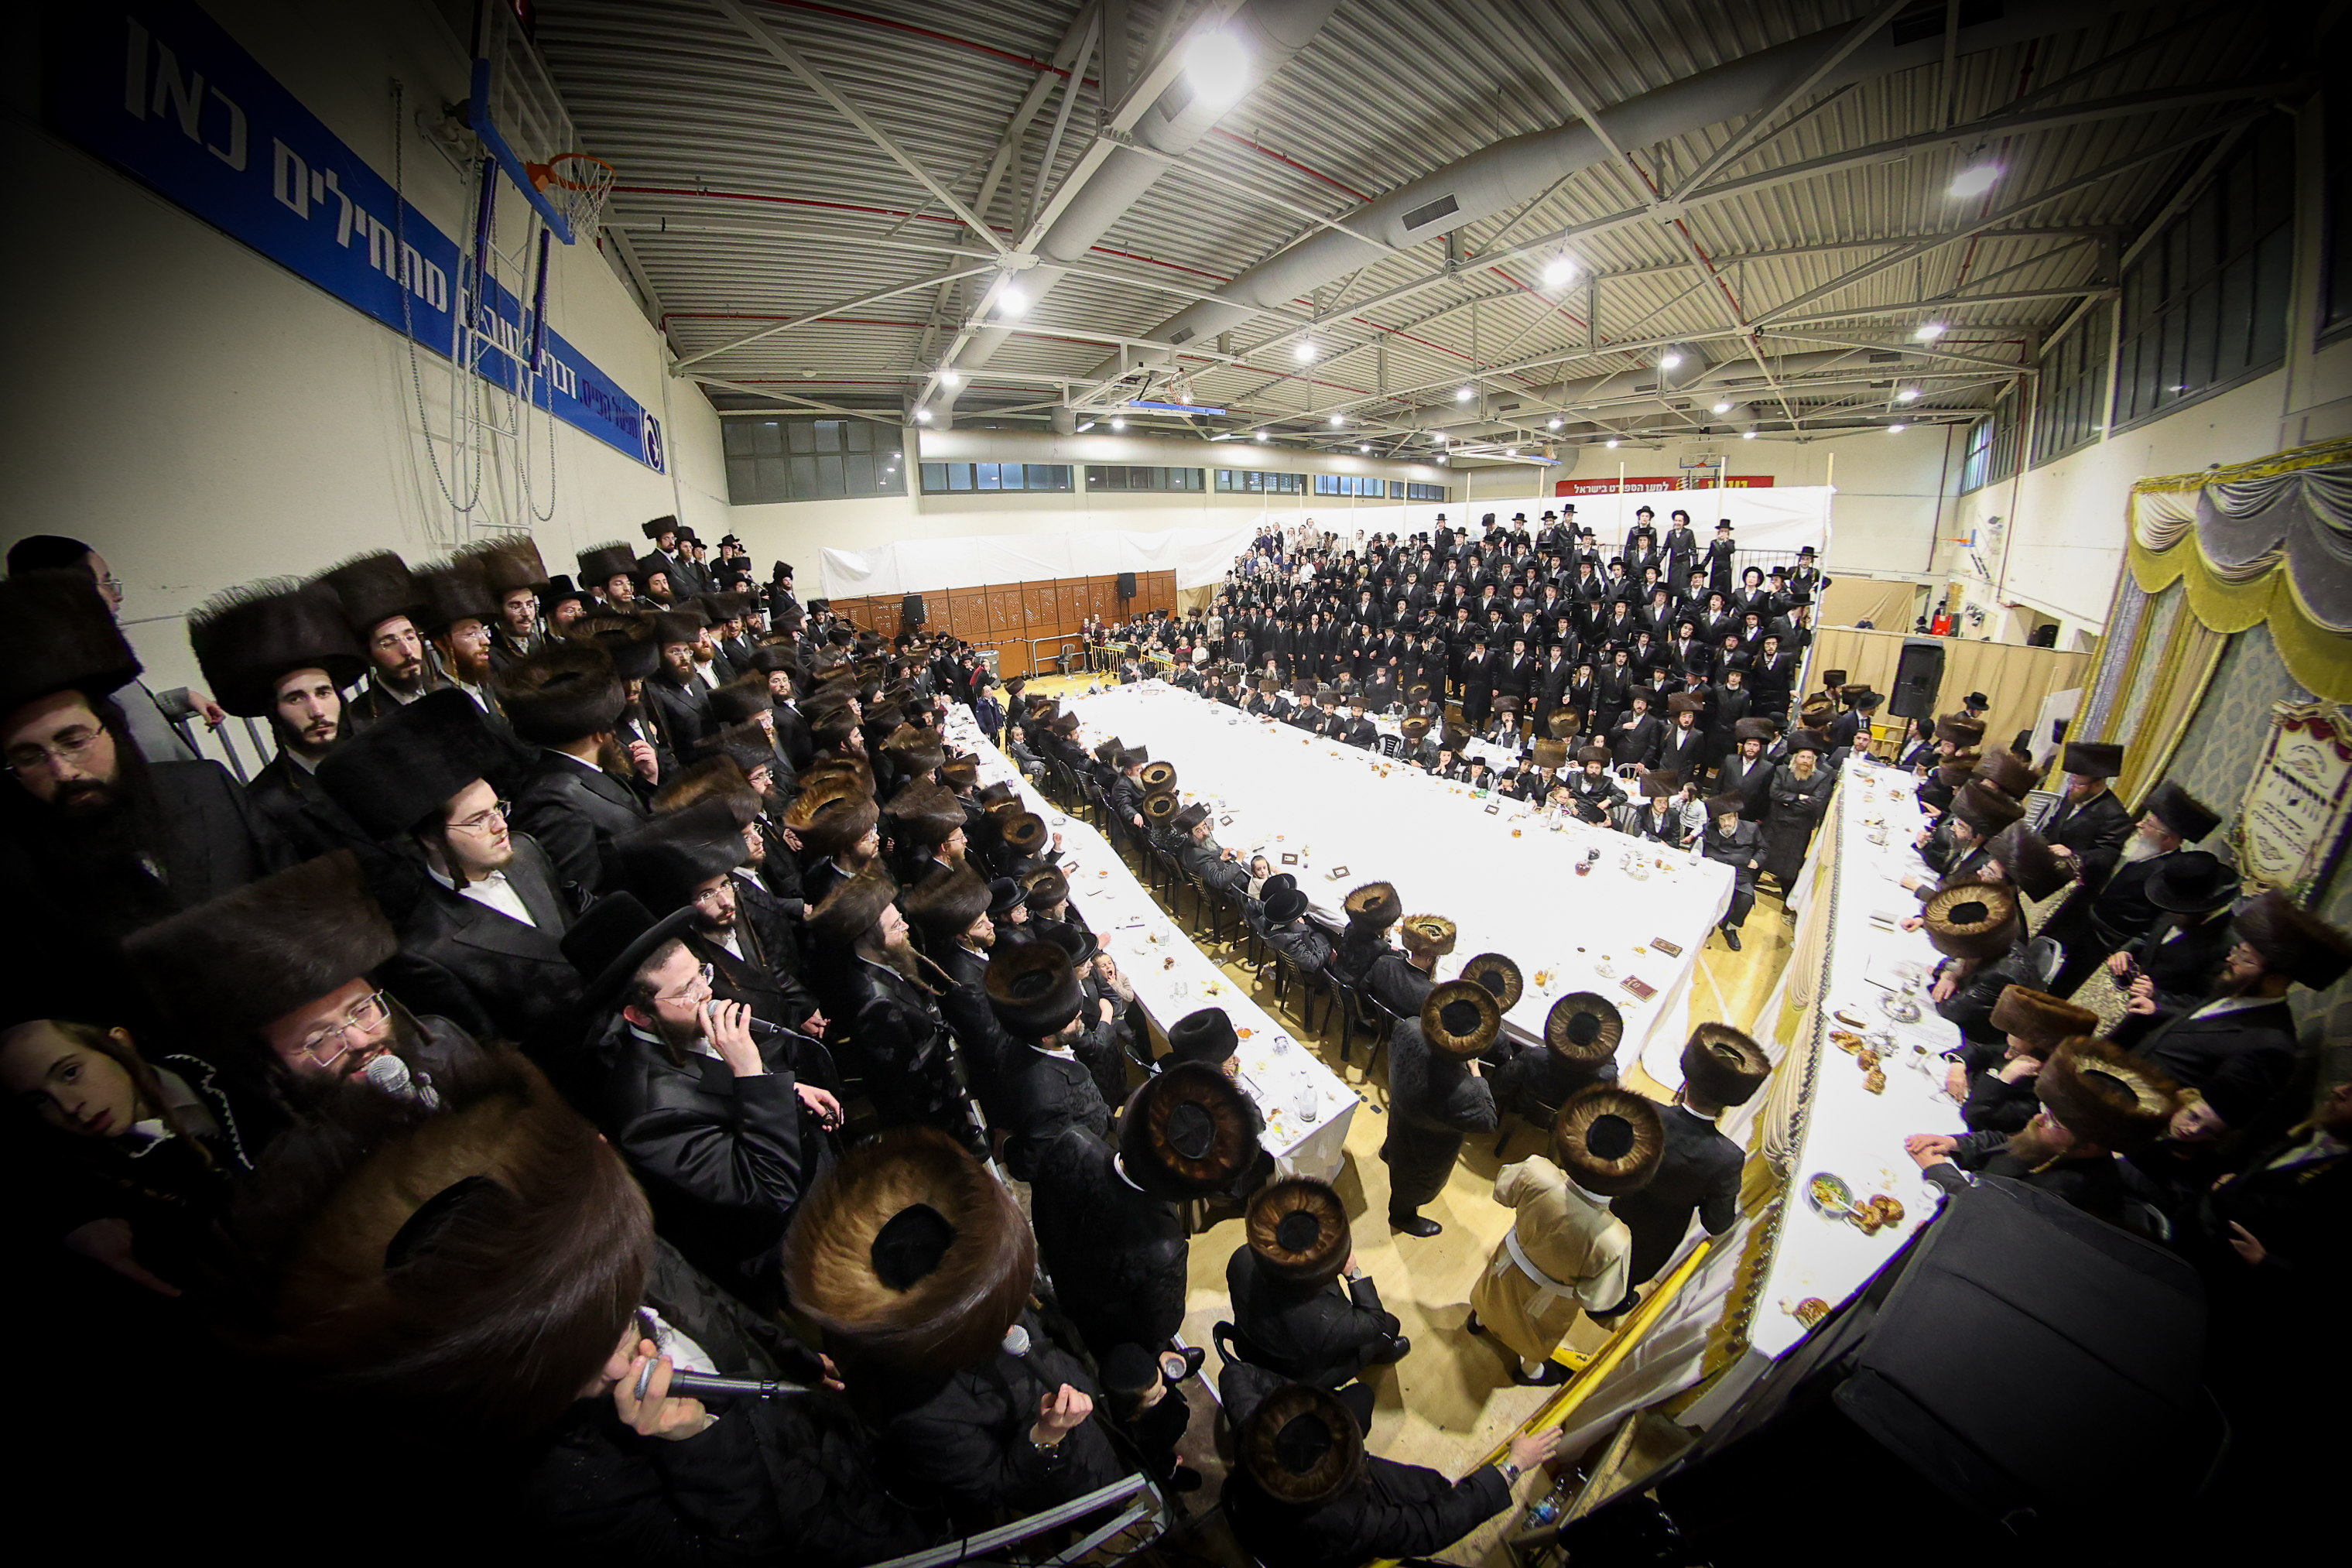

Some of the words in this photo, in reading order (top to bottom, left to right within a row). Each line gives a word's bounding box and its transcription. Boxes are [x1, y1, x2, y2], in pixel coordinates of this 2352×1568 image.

[125, 15, 248, 172] כאן
[273, 136, 446, 313] מתחילים
[1574, 484, 1607, 493] בישראל
[1609, 484, 1643, 492] הספרט
[1645, 481, 1669, 491] למען
